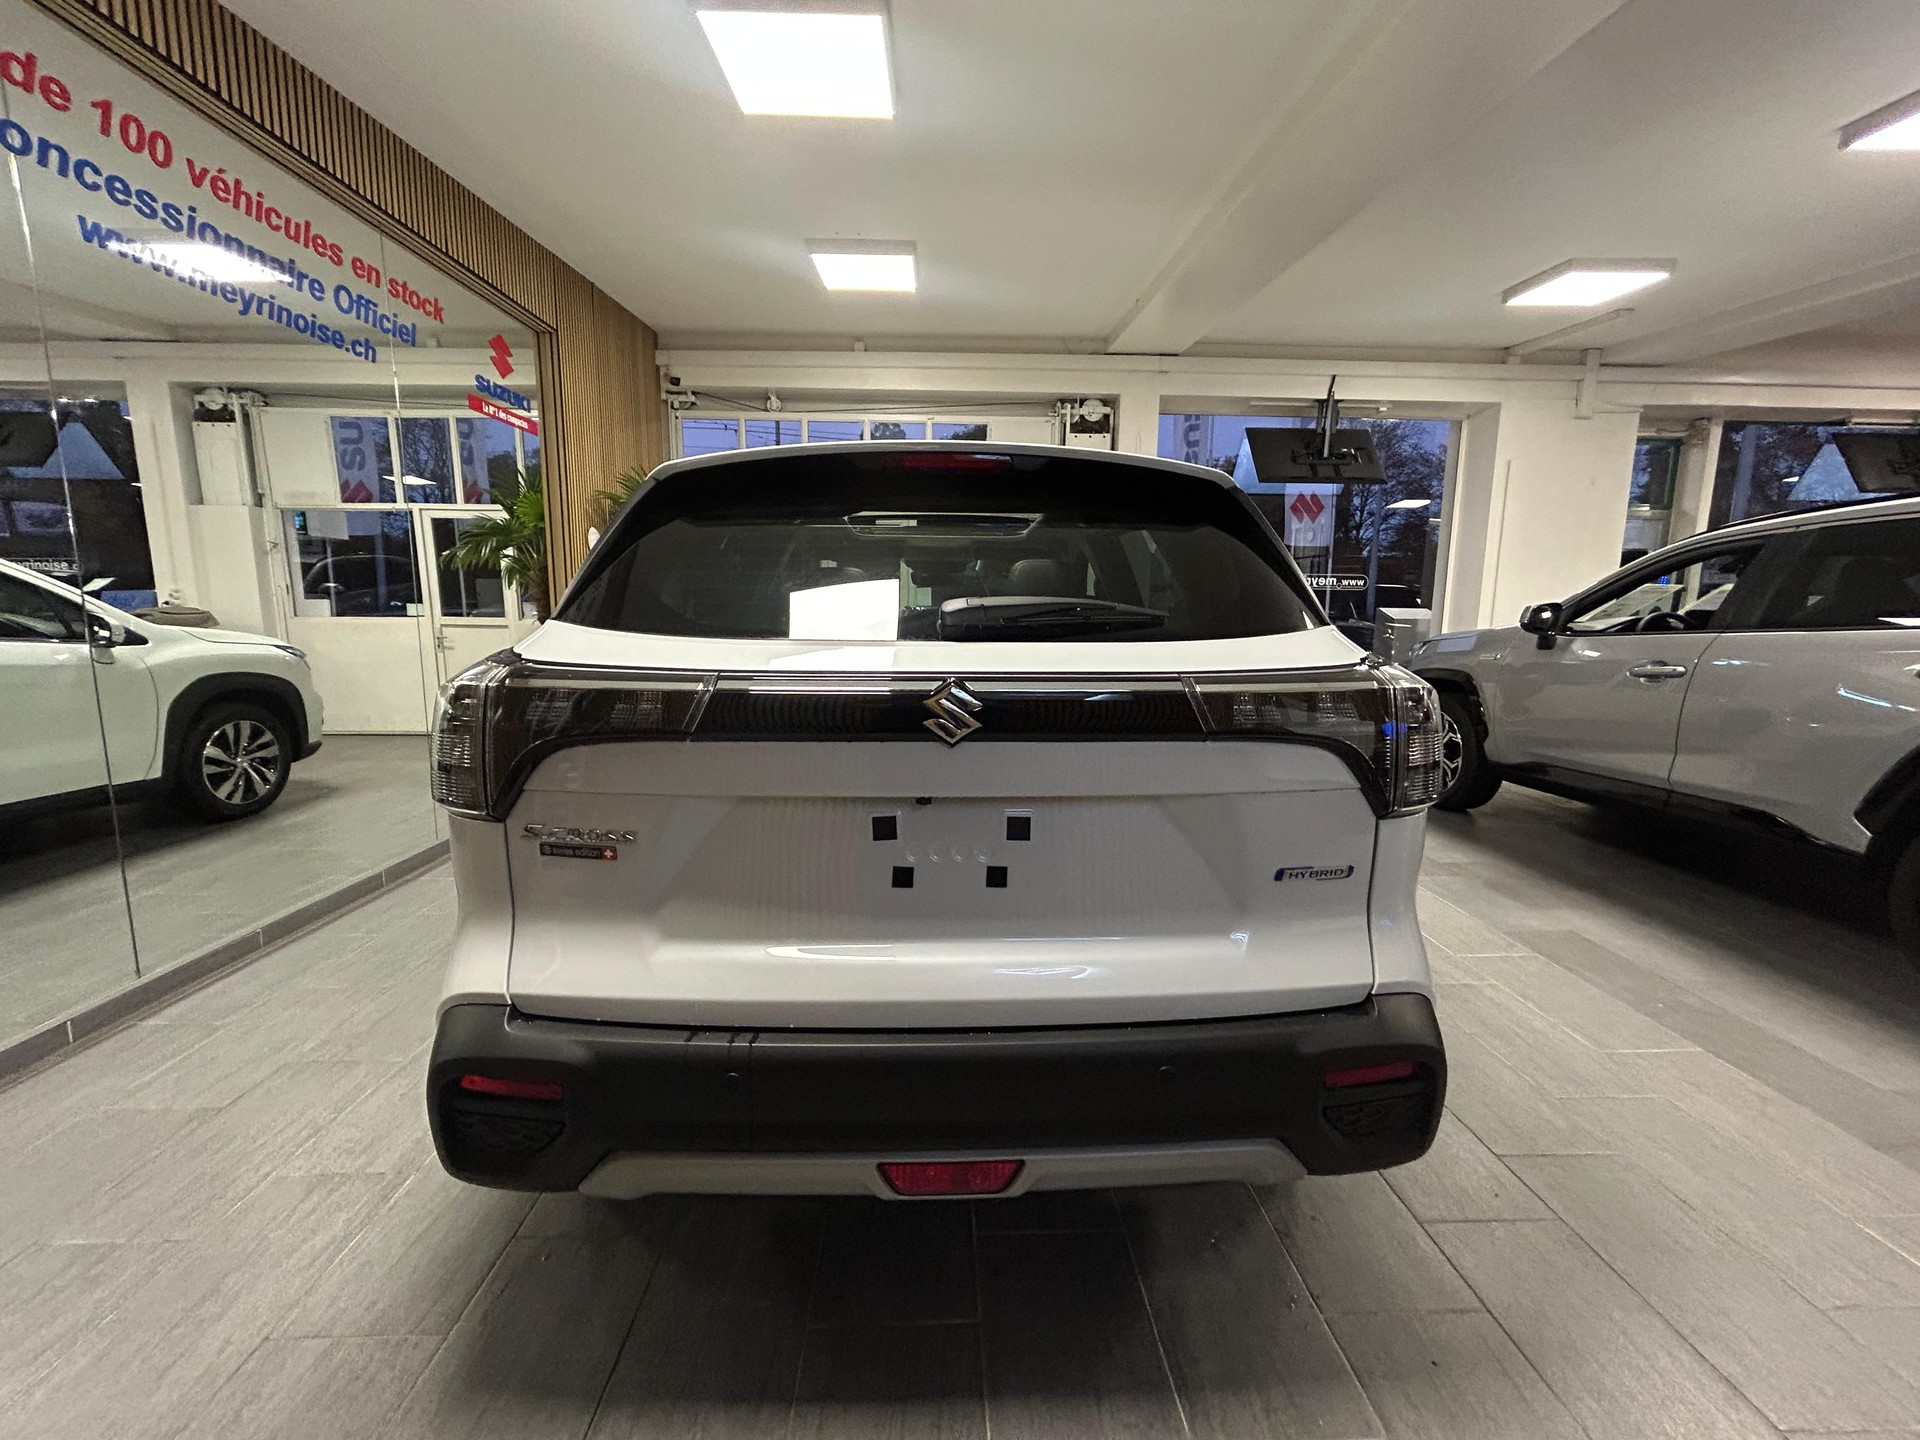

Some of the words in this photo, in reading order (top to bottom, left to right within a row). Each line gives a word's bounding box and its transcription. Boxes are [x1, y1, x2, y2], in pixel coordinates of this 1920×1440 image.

[0, 51, 72, 112] de
[90, 99, 173, 168] 100
[186, 157, 344, 267] véhicules
[351, 256, 381, 288] en
[388, 277, 444, 324] stock
[333, 284, 417, 347] Officiel
[475, 374, 531, 413] SUZUKI
[1287, 868, 1345, 880] HYBRID
